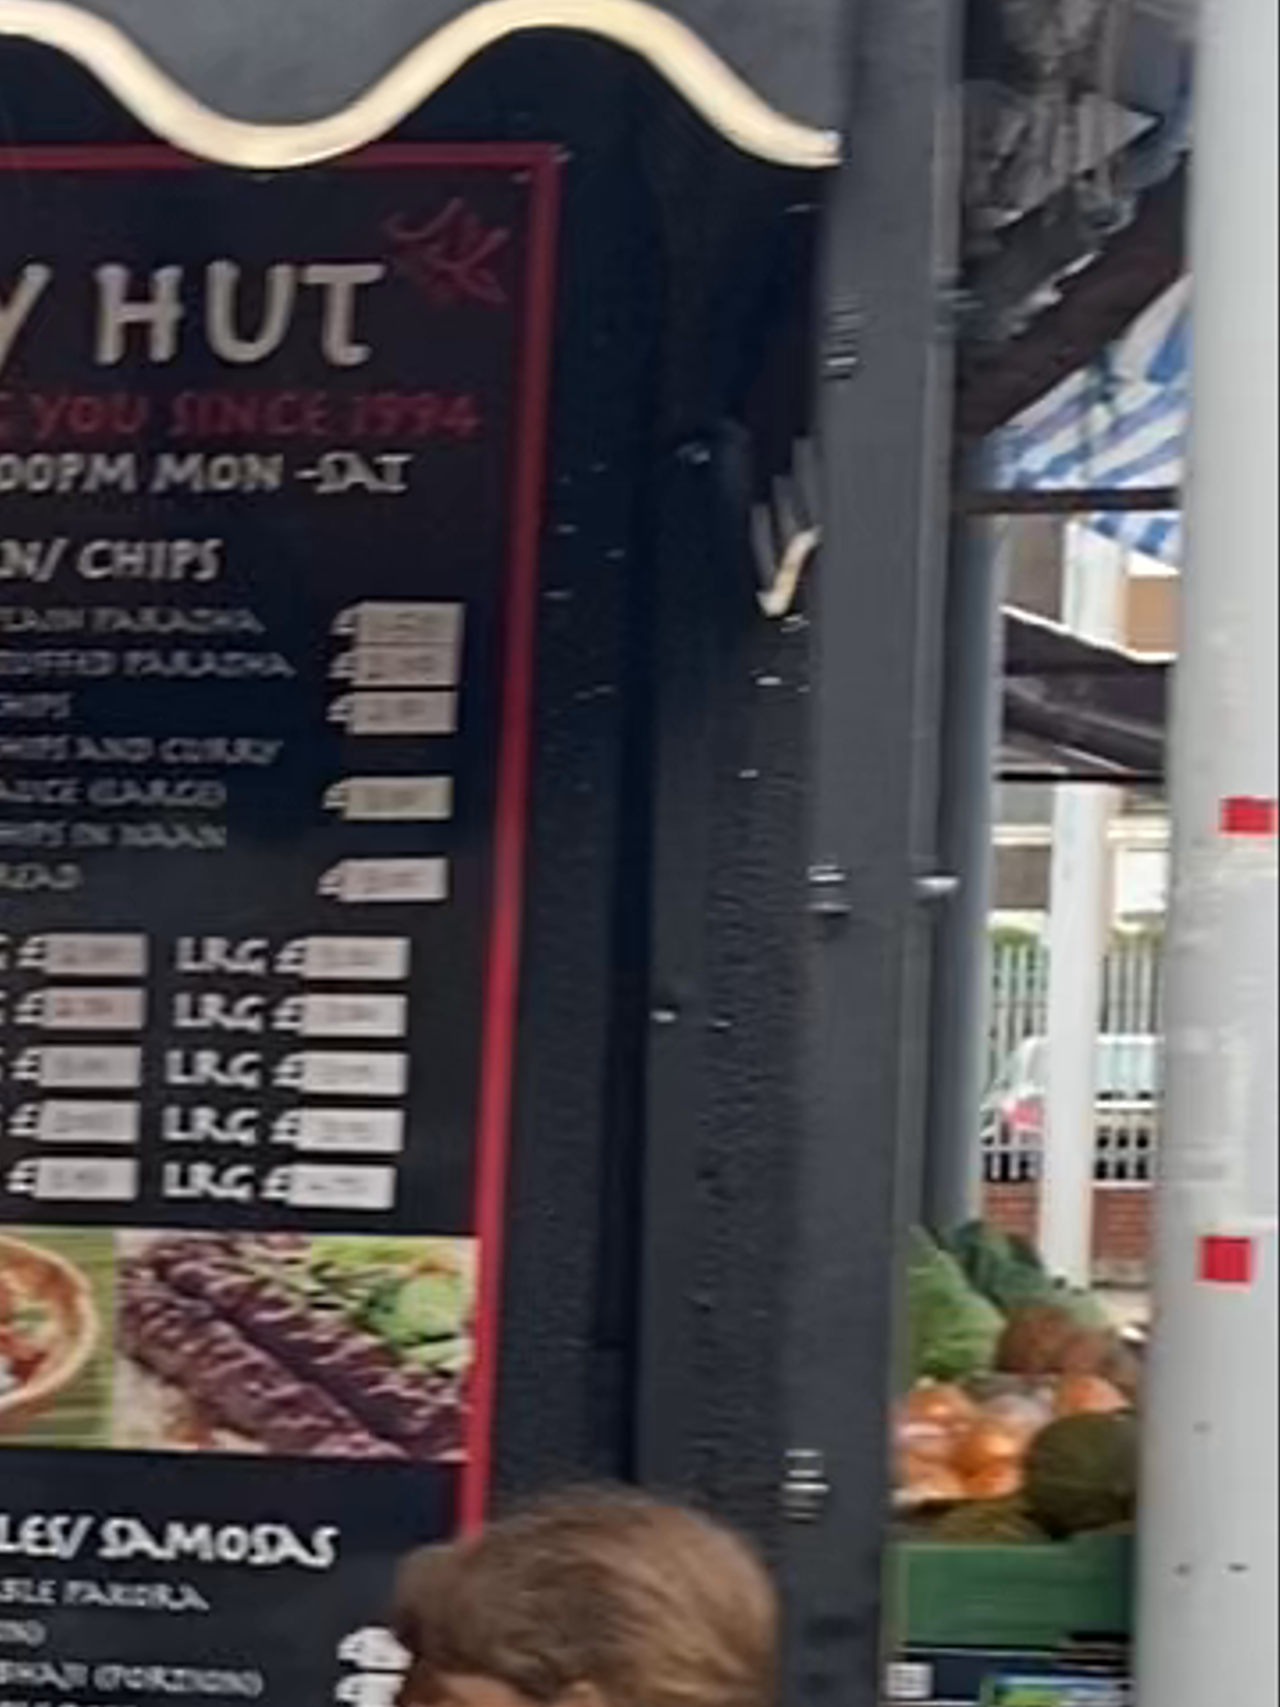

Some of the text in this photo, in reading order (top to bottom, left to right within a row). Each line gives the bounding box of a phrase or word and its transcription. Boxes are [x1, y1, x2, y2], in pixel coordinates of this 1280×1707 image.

[93, 259, 387, 367] HUT
[34, 391, 149, 437] YOU
[167, 392, 332, 438] SINCE
[349, 393, 481, 437] 1994
[153, 453, 286, 493] MON
[75, 538, 224, 583] CHIPS
[174, 936, 269, 974] LRG
[172, 992, 264, 1031] LRG
[164, 1050, 263, 1088] LRG
[162, 1105, 260, 1146] LRG
[161, 1162, 256, 1202] LRG
[97, 1516, 340, 1568] SAMOSAS
